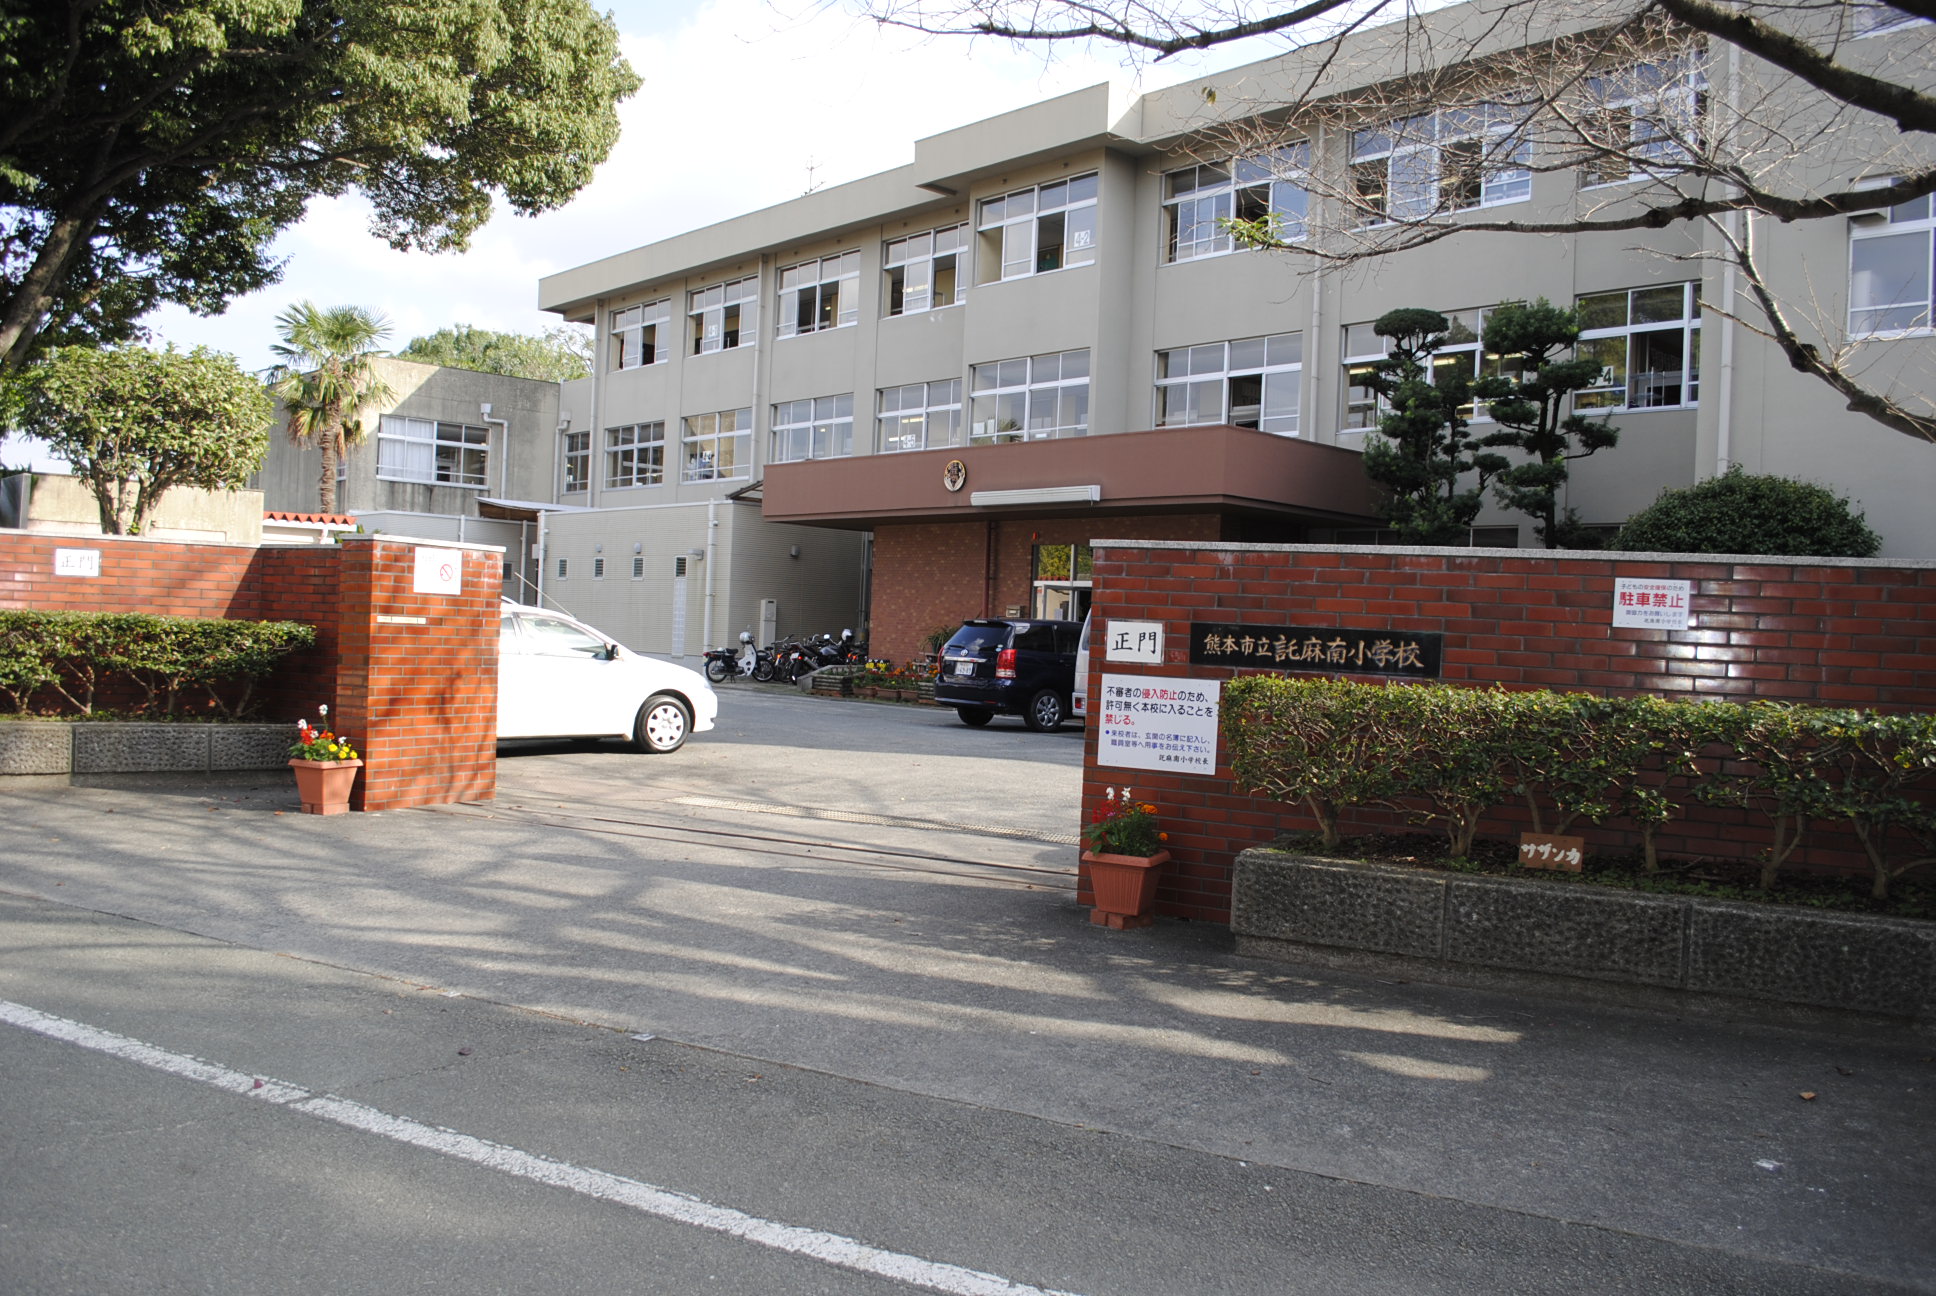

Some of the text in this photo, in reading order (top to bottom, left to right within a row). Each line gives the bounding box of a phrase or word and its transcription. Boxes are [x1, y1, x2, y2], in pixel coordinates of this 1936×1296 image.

[60, 554, 94, 570] 正門
[1619, 592, 1684, 608] 駐車禁止
[1111, 631, 1157, 655] 正門
[1106, 686, 1209, 703] 不審者の侵入防止のため、
[1105, 699, 1213, 718] 許可無く本校に入ることを
[1105, 713, 1135, 726] 禁じる。
[1520, 843, 1581, 865] サザンカ
